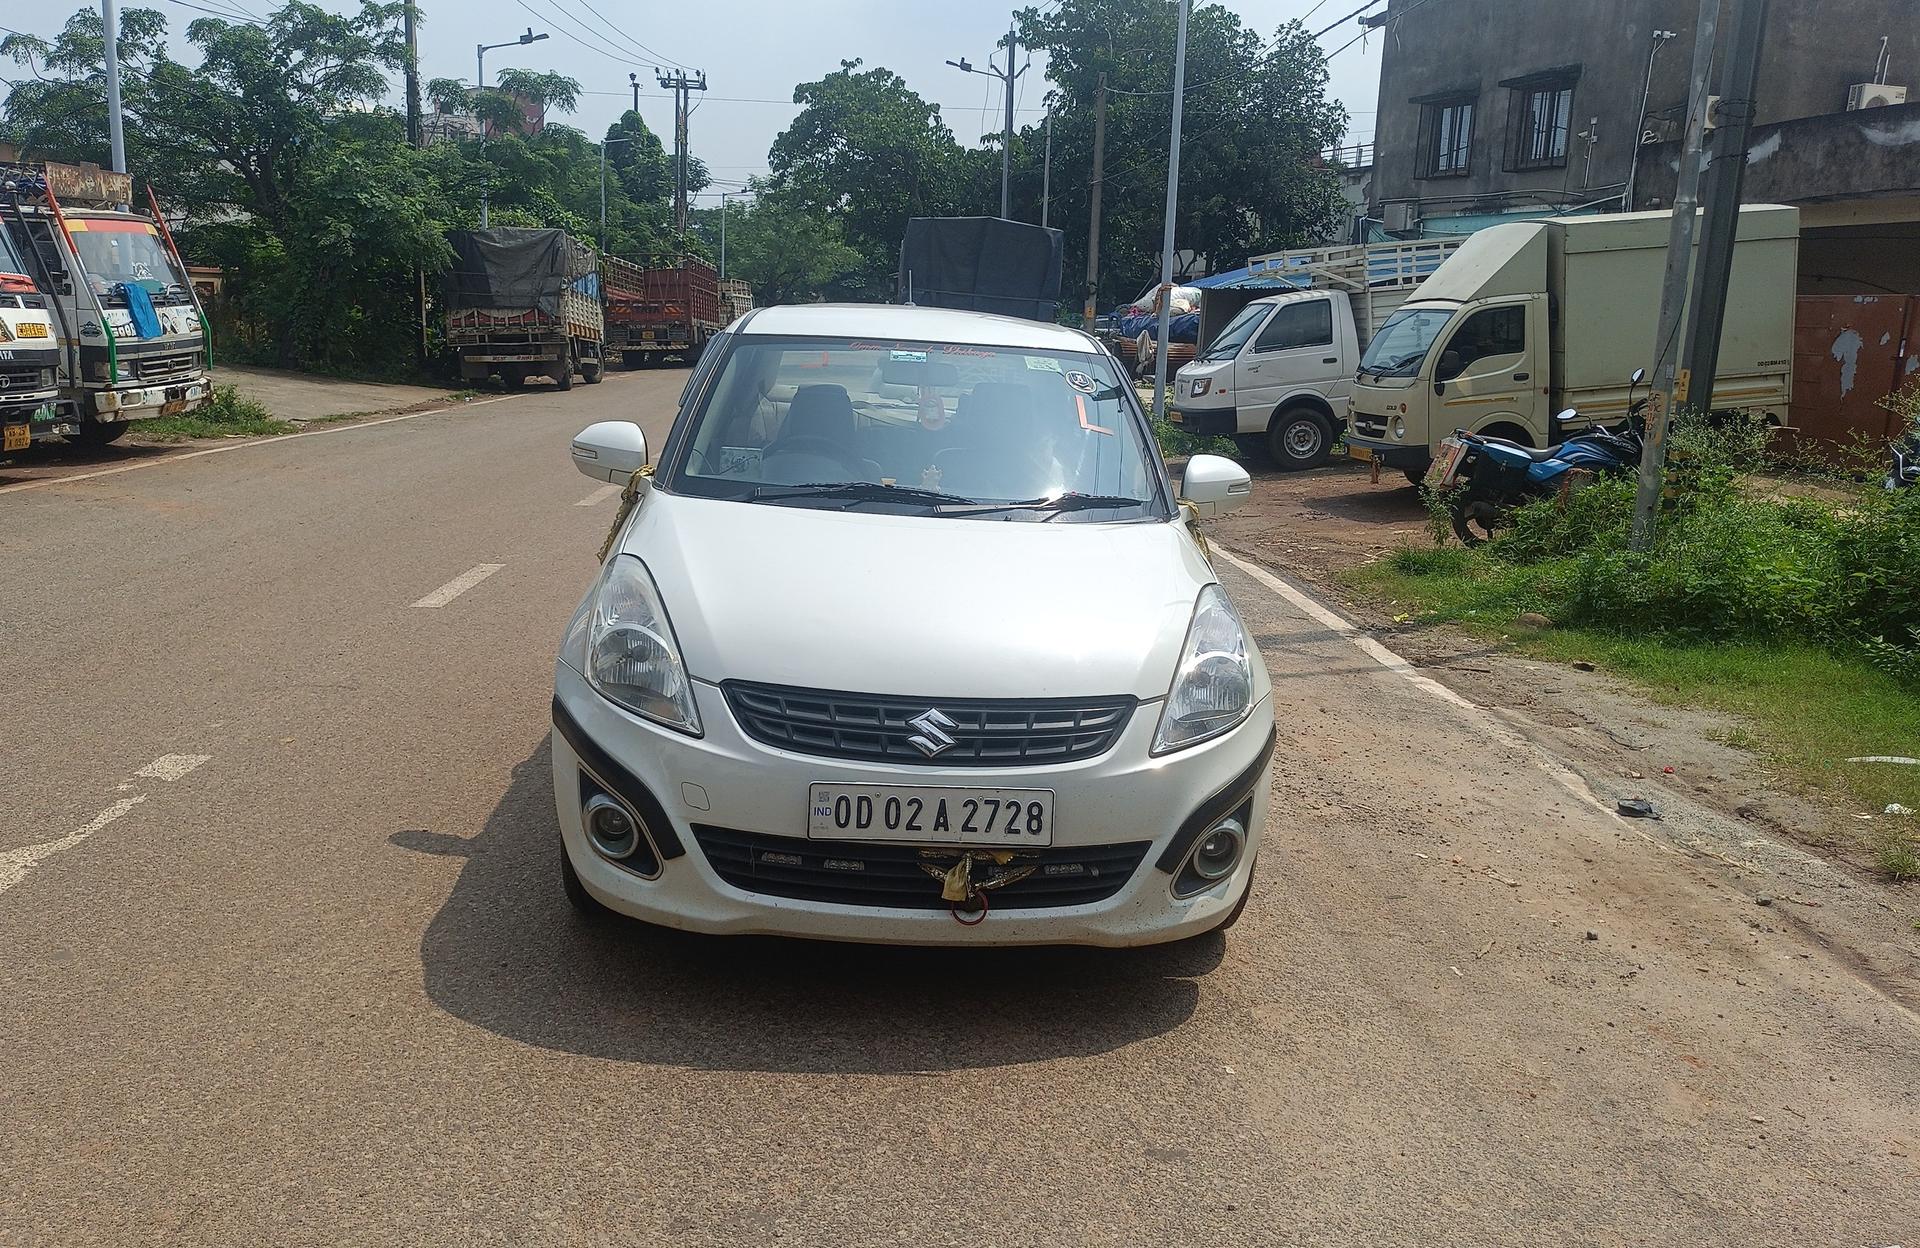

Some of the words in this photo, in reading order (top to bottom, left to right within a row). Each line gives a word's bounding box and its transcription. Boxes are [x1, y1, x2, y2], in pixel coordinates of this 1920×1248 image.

[814, 806, 832, 817] IND
[834, 795, 873, 829] OD
[884, 796, 923, 831] 02
[933, 798, 949, 831] A
[961, 799, 1044, 835] 2728
